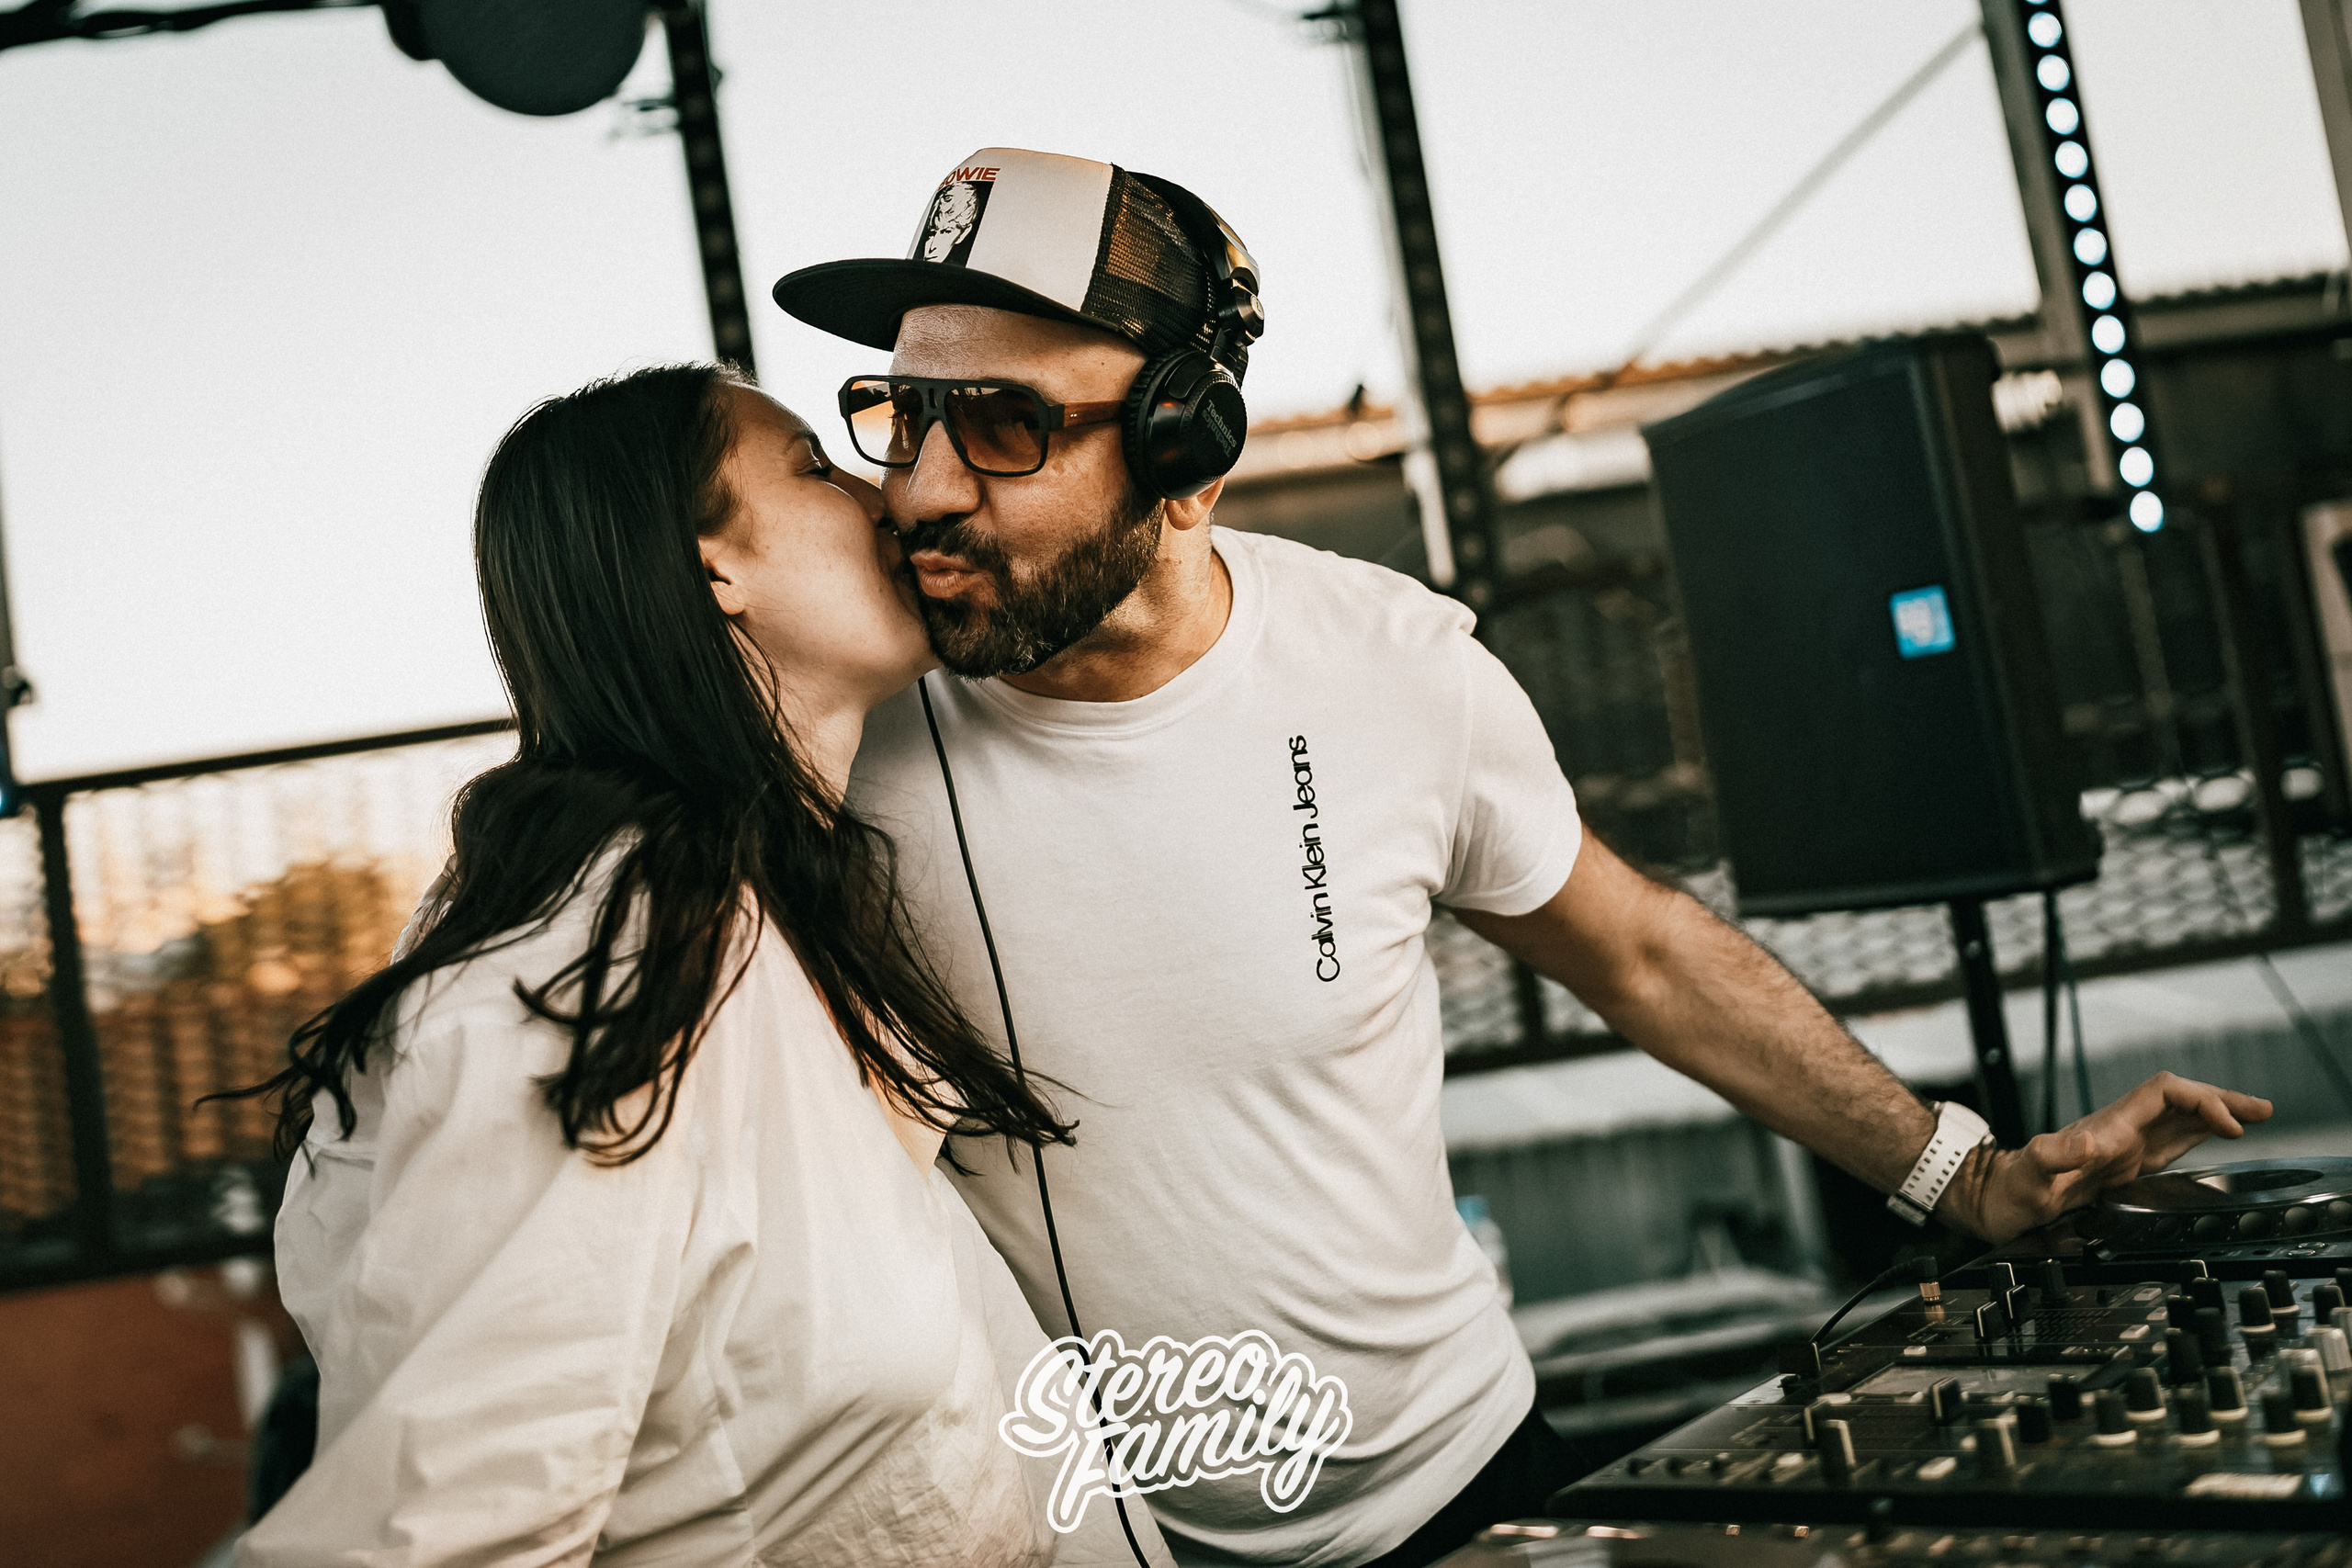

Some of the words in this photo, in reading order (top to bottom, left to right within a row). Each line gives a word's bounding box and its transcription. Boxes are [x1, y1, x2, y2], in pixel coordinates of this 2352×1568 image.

[1201, 409, 1232, 458] Technics
[1205, 399, 1238, 448] Technics
[1288, 734, 1318, 819] Jeans
[1298, 822, 1327, 890] Klein
[1310, 891, 1340, 983] Calvin
